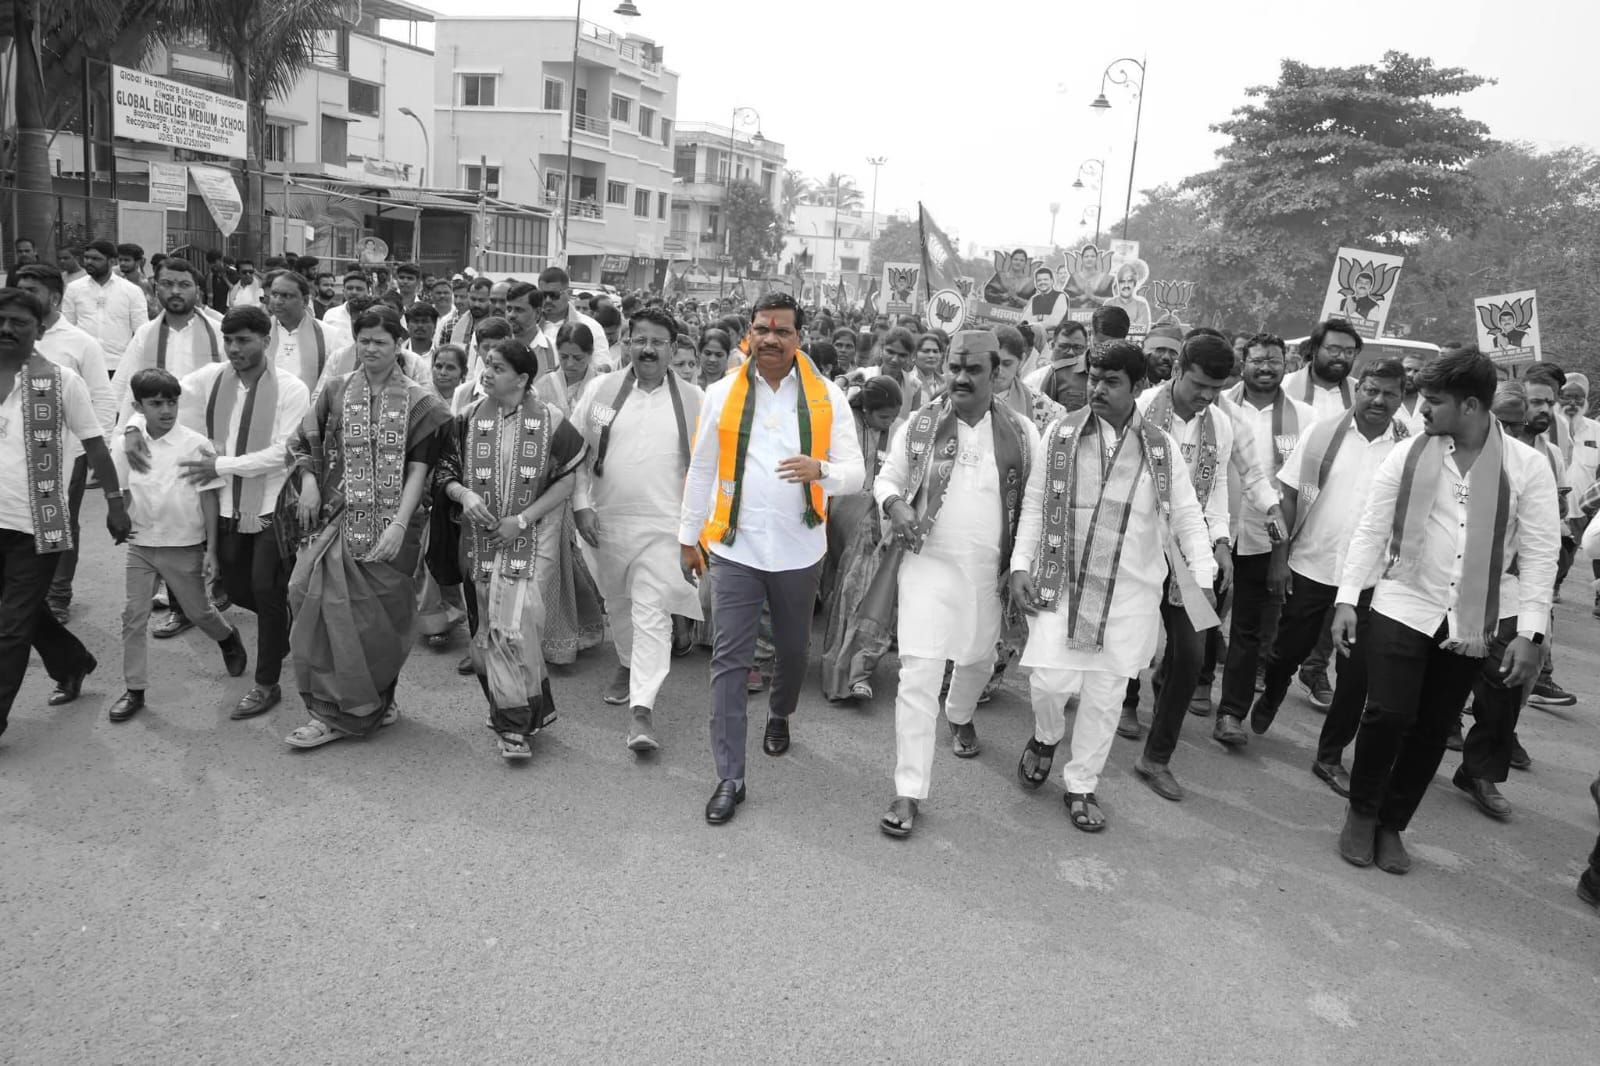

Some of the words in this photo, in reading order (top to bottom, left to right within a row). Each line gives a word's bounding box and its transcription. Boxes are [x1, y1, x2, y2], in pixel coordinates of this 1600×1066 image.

[119, 70, 140, 84] Global
[144, 77, 179, 94] Healthcare
[215, 96, 243, 110] Foundation
[116, 89, 150, 111] GLOBAL
[153, 98, 186, 119] ENGLISH
[189, 107, 217, 126] MEDIUM
[220, 115, 245, 132] SCHOOL
[126, 115, 159, 131] Recognized
[162, 123, 169, 133] By
[34, 403, 51, 420] B
[351, 424, 362, 437] B
[916, 416, 931, 432] B
[384, 431, 398, 446] B
[477, 442, 491, 458] B
[522, 441, 537, 457] B
[37, 453, 52, 472] J
[1054, 451, 1066, 469] B
[354, 467, 365, 481] J
[383, 474, 394, 488] J
[518, 490, 532, 505] J
[41, 504, 57, 523] P
[355, 509, 366, 523] P
[1051, 506, 1062, 524] J
[513, 537, 528, 552] P
[1045, 560, 1059, 578] P
